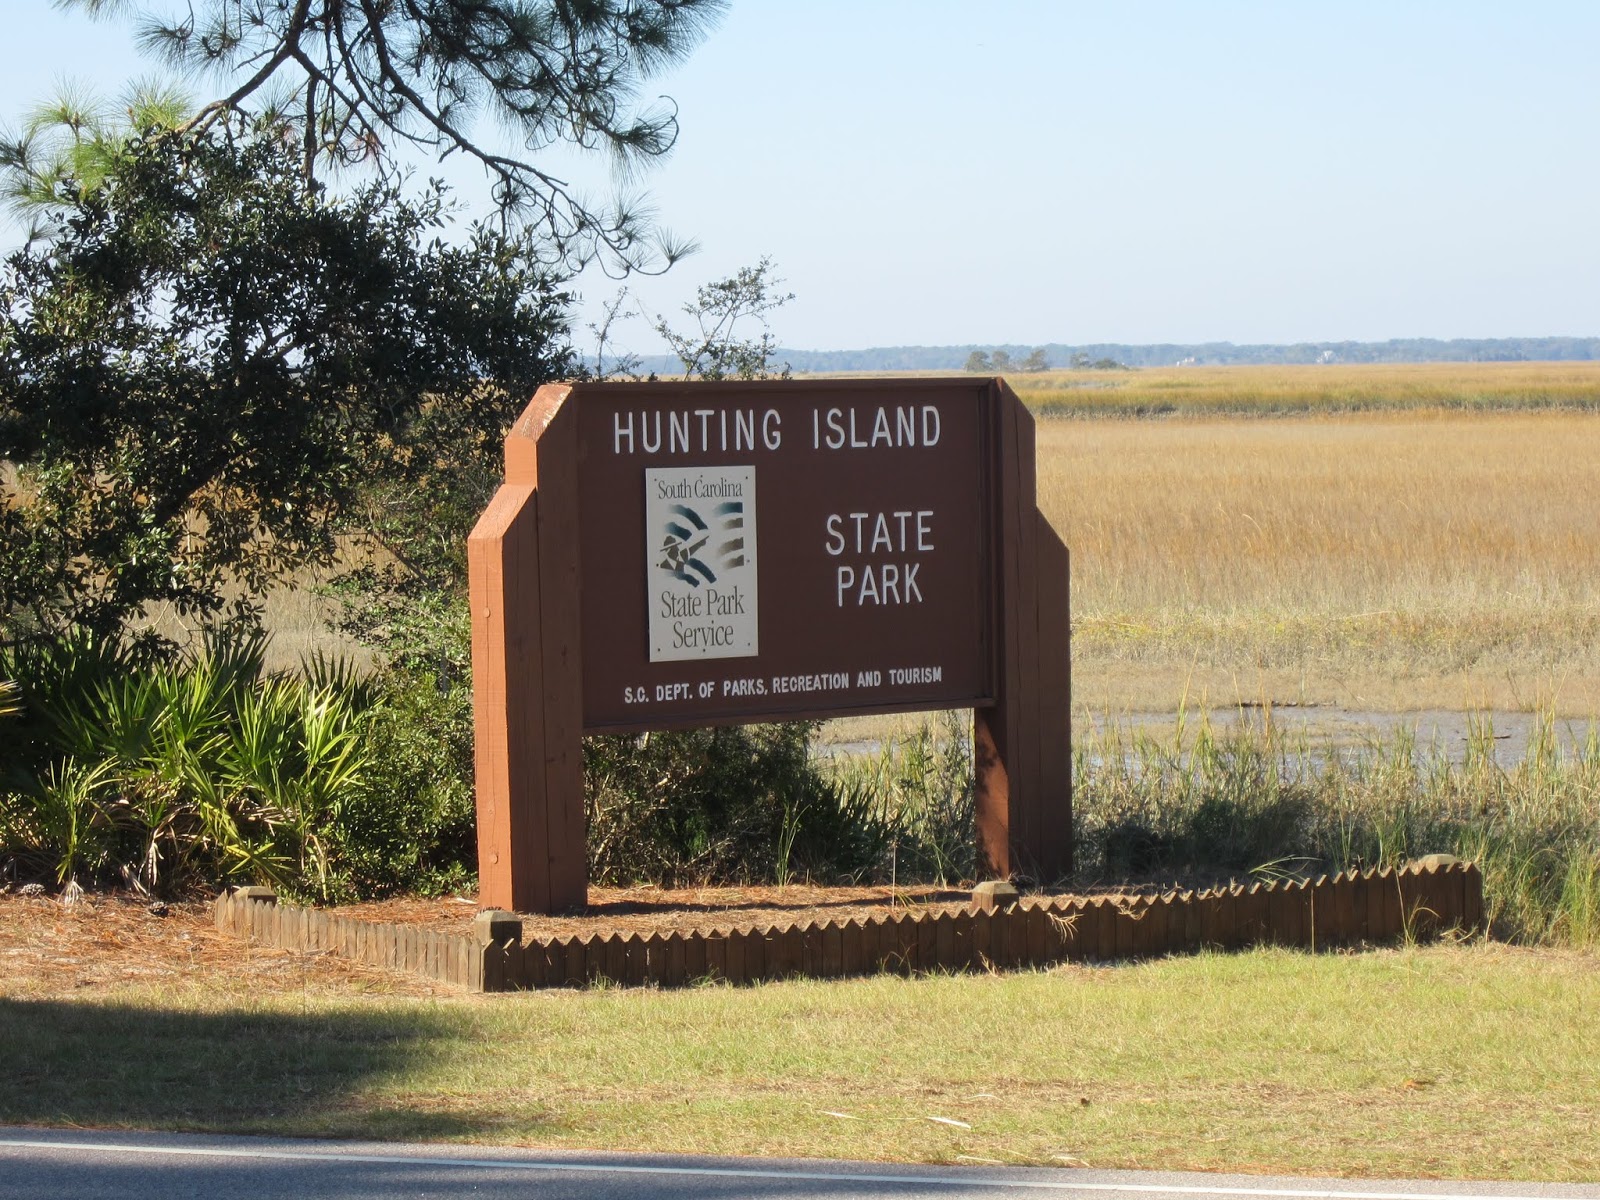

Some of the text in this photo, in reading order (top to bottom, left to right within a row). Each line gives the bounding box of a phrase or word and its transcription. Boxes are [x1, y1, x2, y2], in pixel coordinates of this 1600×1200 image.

[615, 406, 940, 453] HUNTING ISLAND
[658, 477, 742, 499] South Carolina
[826, 511, 934, 555] STATE
[661, 586, 744, 618] State Park
[838, 563, 922, 607] PARK
[673, 620, 733, 648] Service
[625, 666, 941, 703] S.C. DEPT. OF PARKS, RECREATION AND TOURISM
